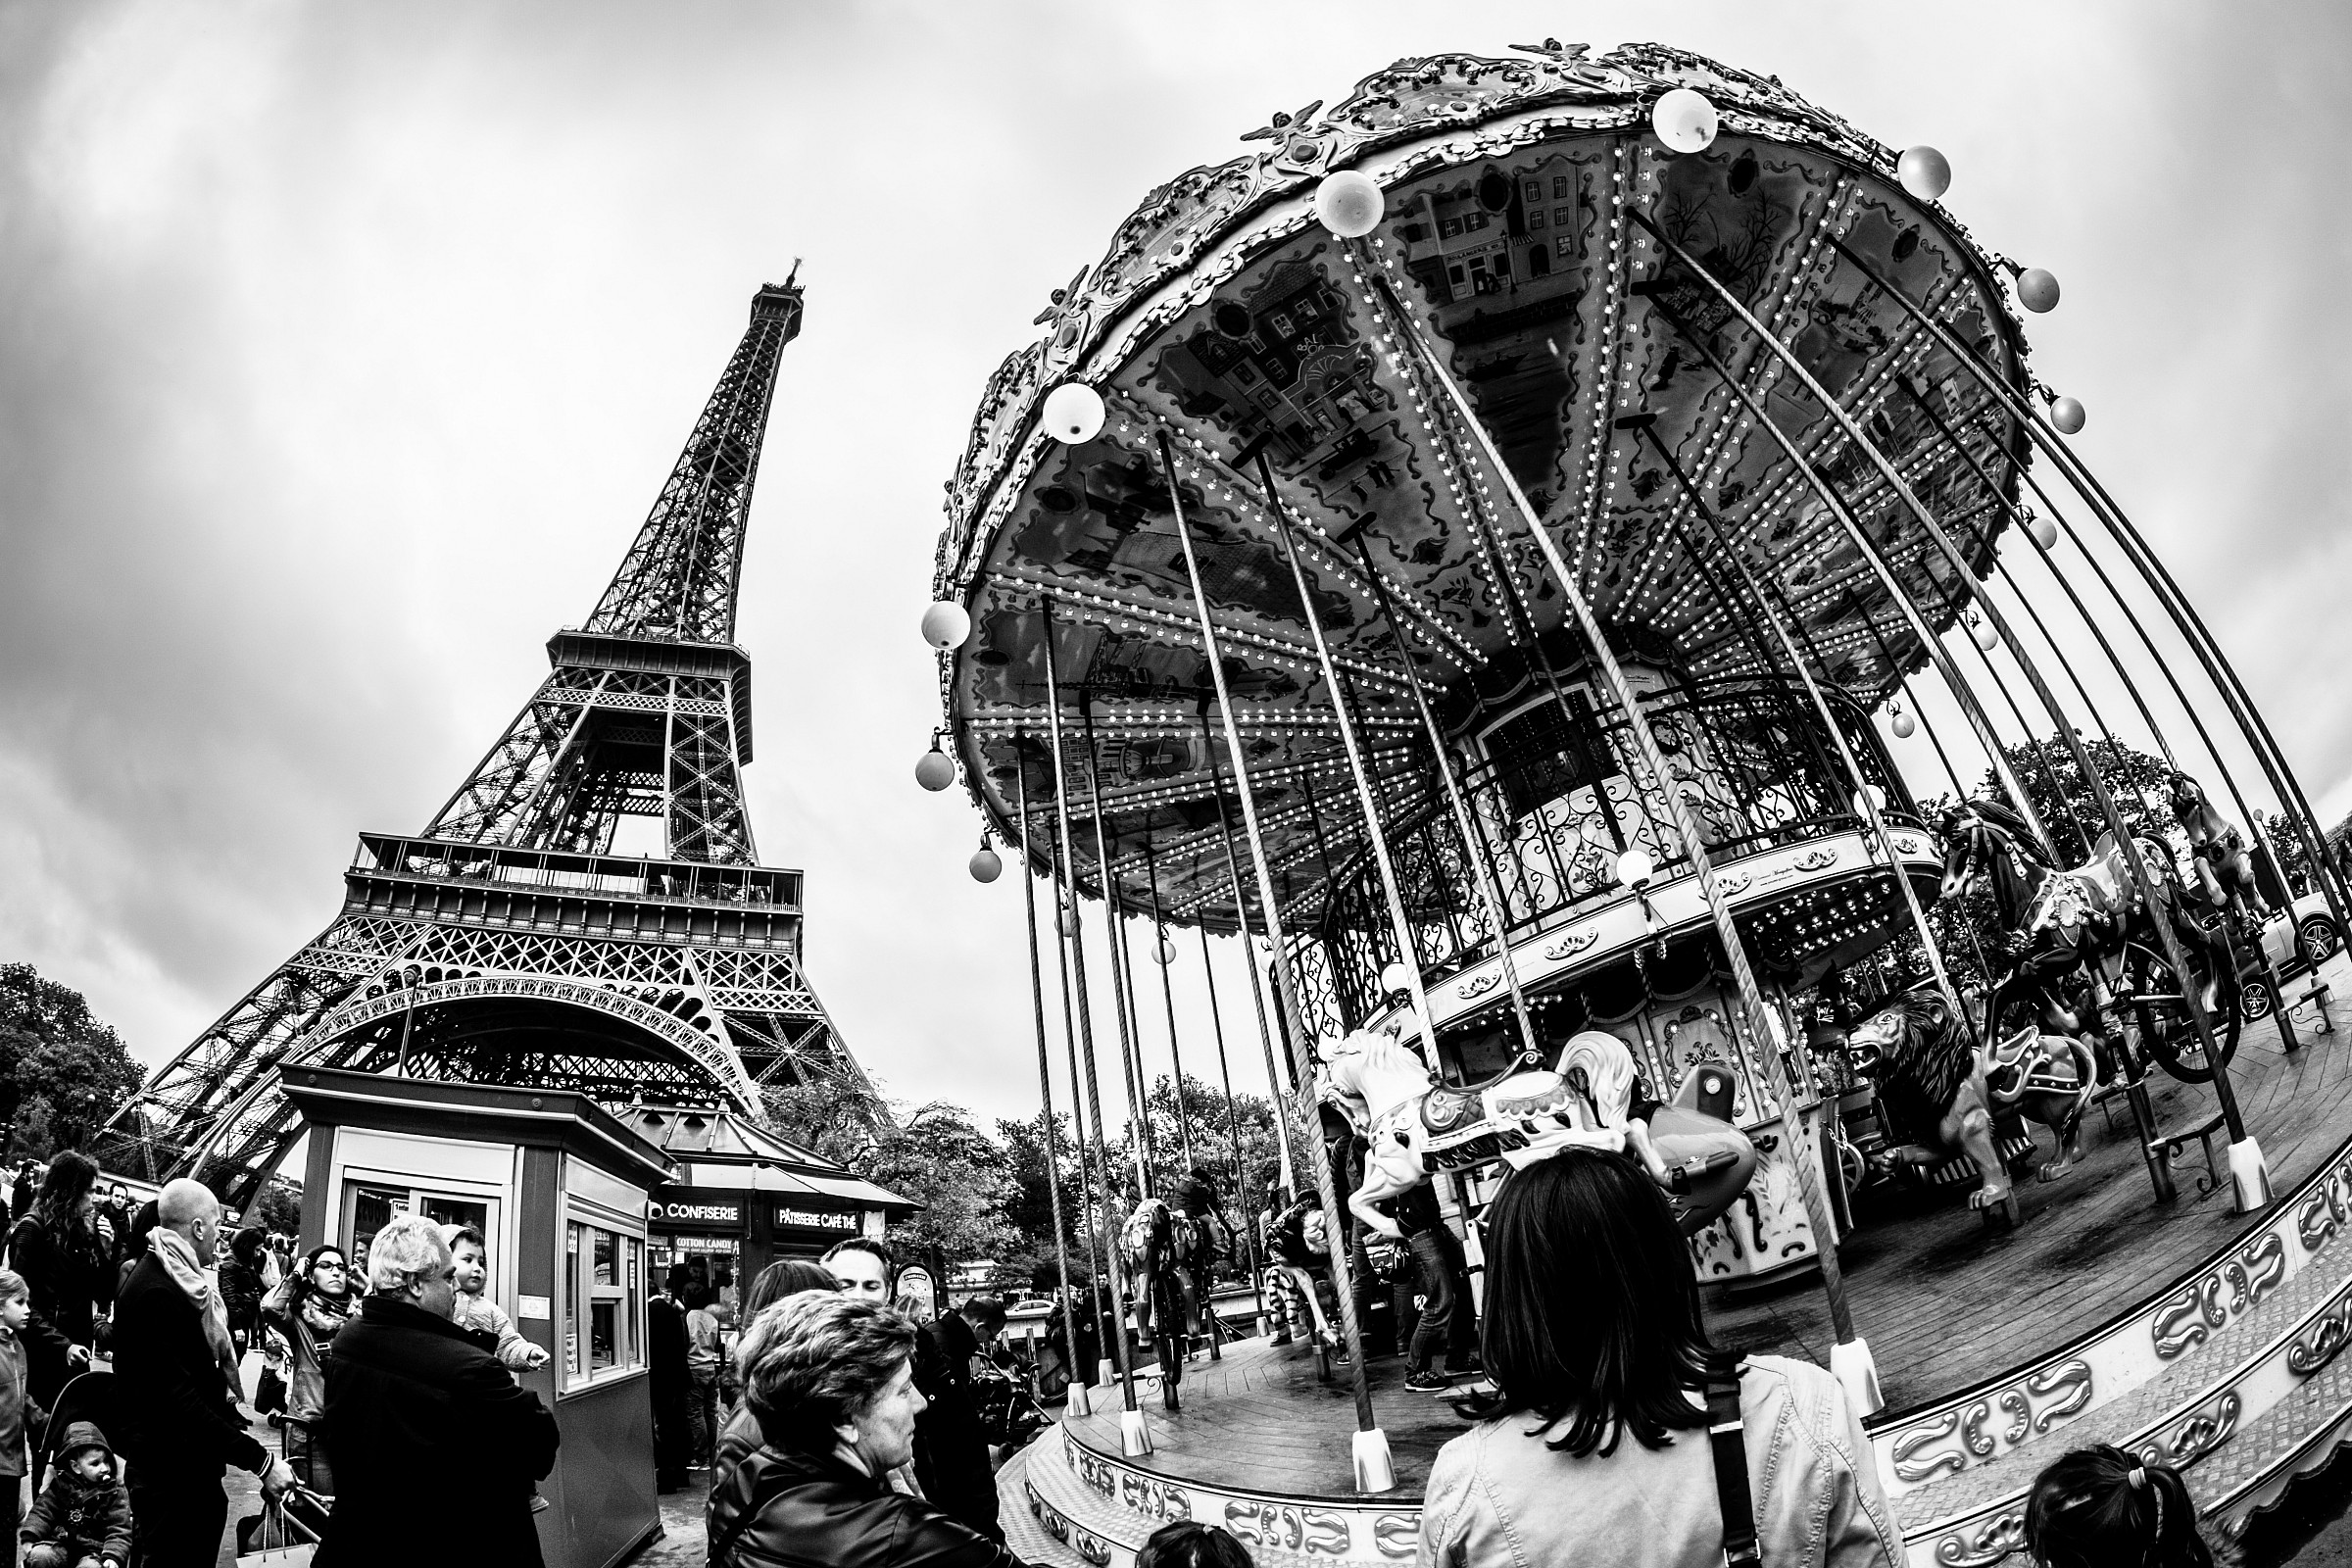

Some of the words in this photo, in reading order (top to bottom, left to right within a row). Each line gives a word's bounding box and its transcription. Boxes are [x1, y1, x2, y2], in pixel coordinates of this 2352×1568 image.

[1297, 333, 1319, 352] BAL
[666, 1202, 738, 1221] CONFISERIE
[779, 1207, 820, 1227] PÂTISSERIE
[820, 1213, 842, 1229] CAFÉ
[842, 1214, 857, 1230] THÉ
[676, 1237, 705, 1249] COTTON
[706, 1239, 732, 1250] CANDY
